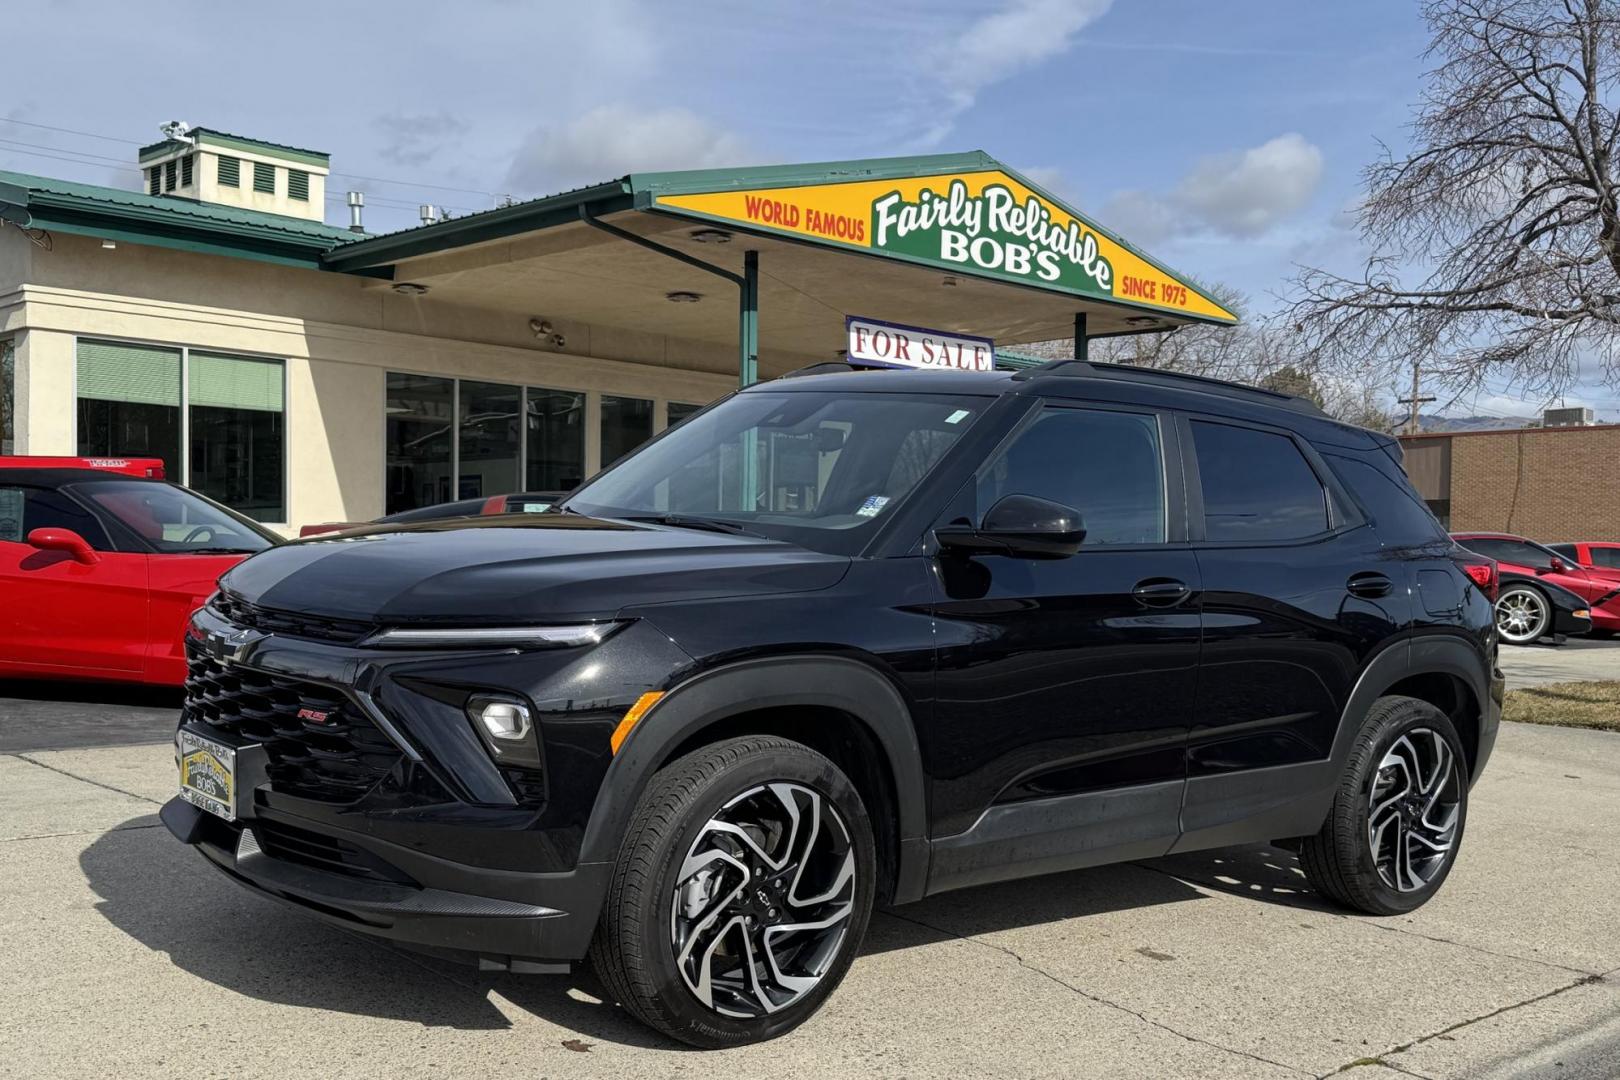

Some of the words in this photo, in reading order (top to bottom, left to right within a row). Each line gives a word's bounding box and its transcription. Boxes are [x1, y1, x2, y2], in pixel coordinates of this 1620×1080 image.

[745, 195, 800, 228] WORLD
[806, 208, 865, 242] FAMOUS
[875, 182, 983, 247] Fairly
[985, 187, 1111, 290] Reliable
[941, 229, 1061, 281] BOB'S
[1122, 275, 1156, 300] SINCE
[1161, 283, 1187, 306] 1975
[854, 326, 911, 361] FOR
[921, 337, 989, 371] SALE
[297, 707, 328, 722] RS
